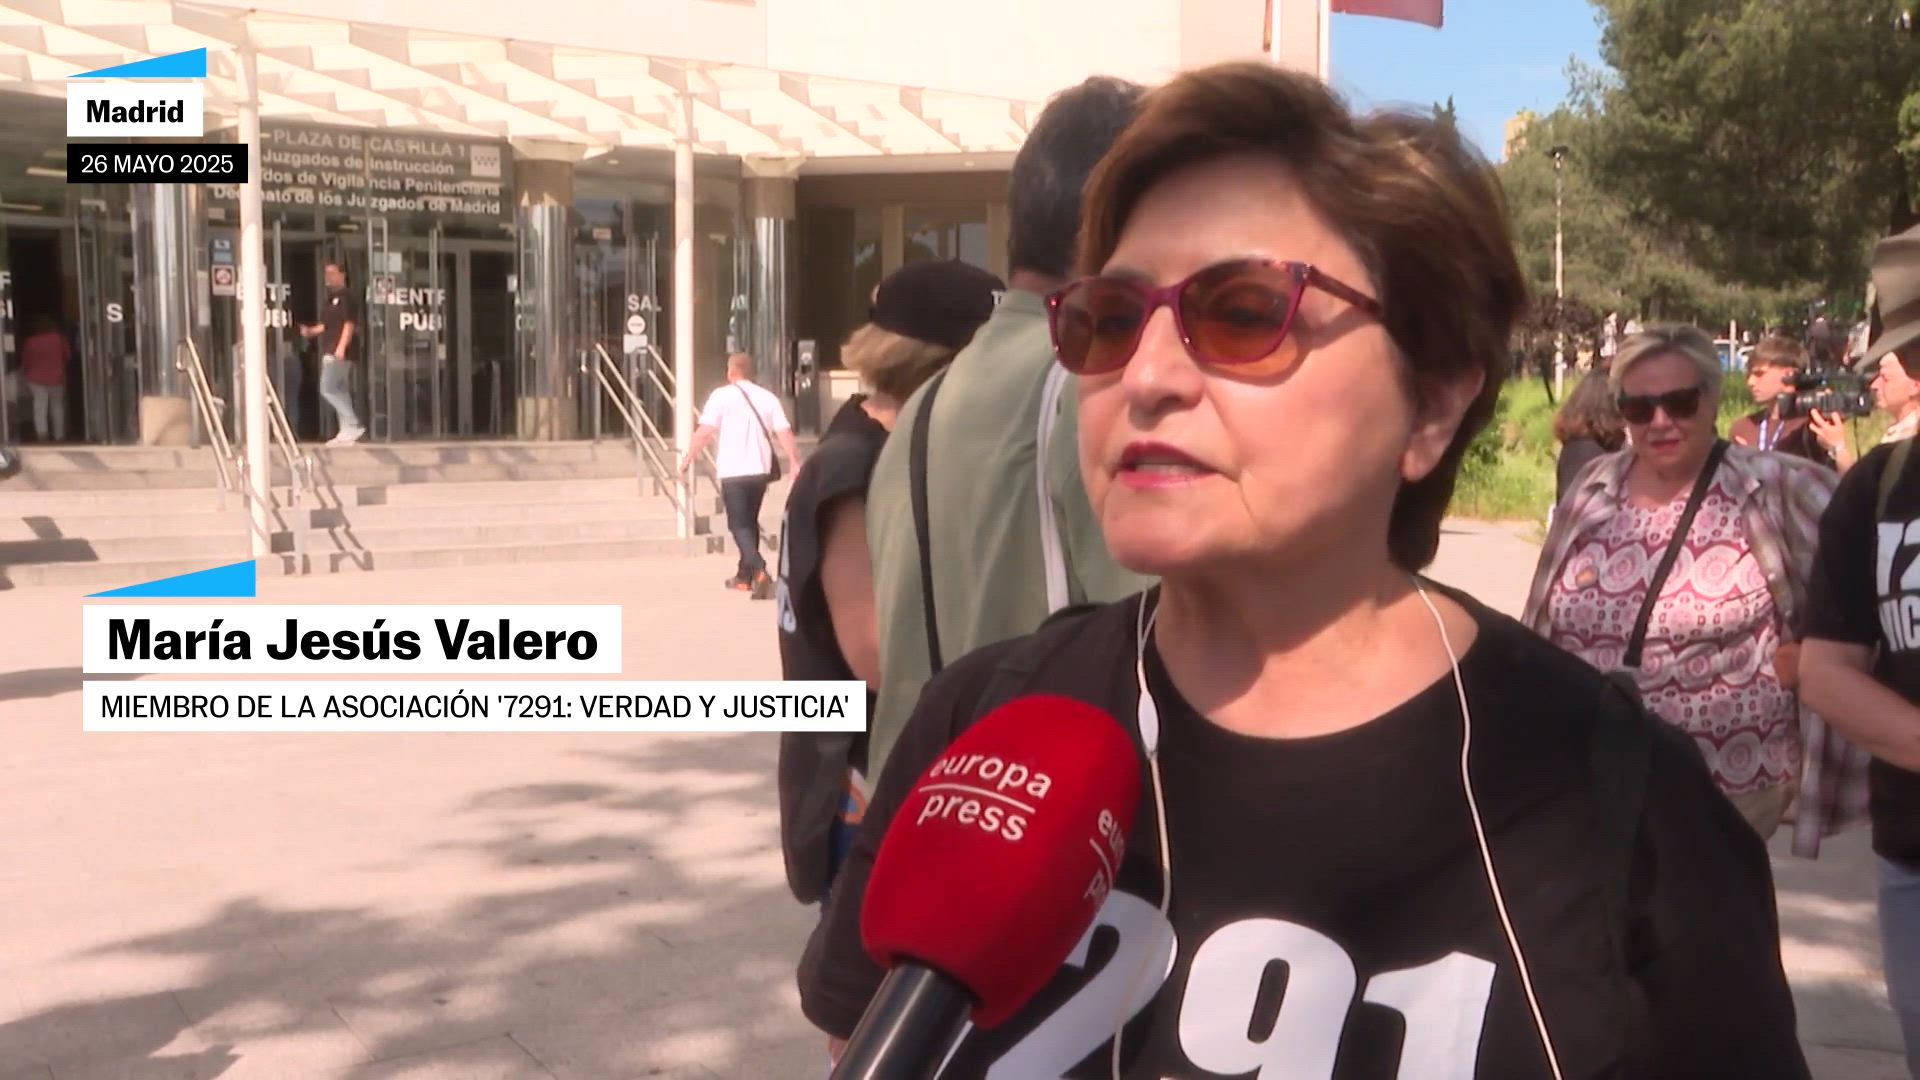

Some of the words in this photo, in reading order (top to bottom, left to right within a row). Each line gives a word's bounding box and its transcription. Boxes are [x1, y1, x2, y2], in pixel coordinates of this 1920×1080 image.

[273, 129, 333, 148] PLAZA
[338, 134, 362, 151] DE
[262, 149, 340, 168] Juzgados
[344, 154, 364, 169] de
[370, 157, 454, 176] Instrucción
[297, 172, 317, 185] de
[294, 187, 315, 205] de
[318, 191, 343, 206] los
[347, 193, 424, 212] Juzgados
[428, 202, 448, 212] de
[450, 199, 500, 215] Madrid
[930, 755, 1052, 799] europa
[917, 794, 1027, 841] press
[932, 888, 1498, 1080] 291
